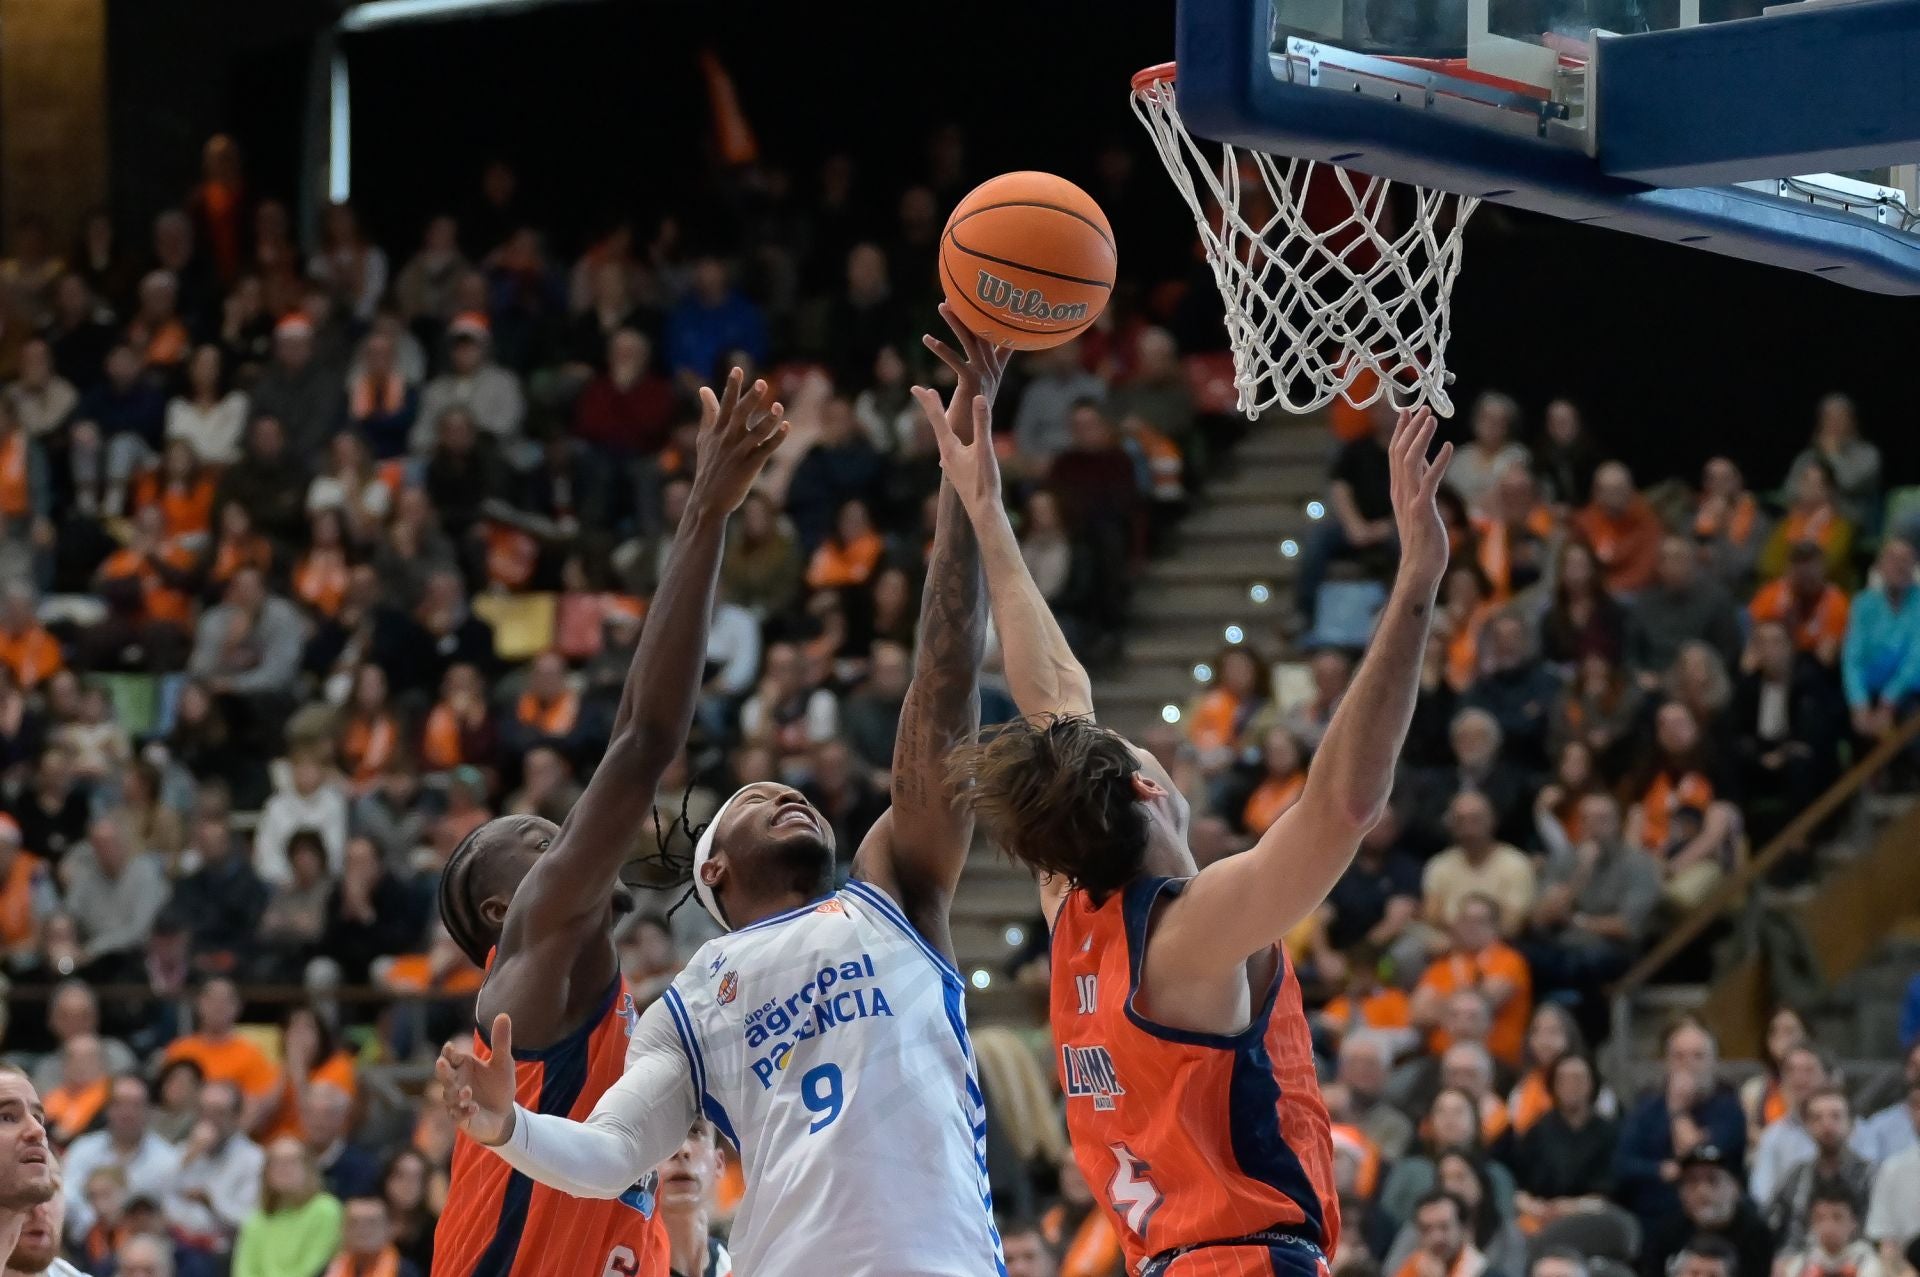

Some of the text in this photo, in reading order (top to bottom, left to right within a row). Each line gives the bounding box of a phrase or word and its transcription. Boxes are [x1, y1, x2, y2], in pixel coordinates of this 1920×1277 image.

[976, 269, 1088, 320] Wilson
[744, 997, 776, 1028] úper
[745, 954, 876, 1048] agropal
[801, 1062, 844, 1136] 9
